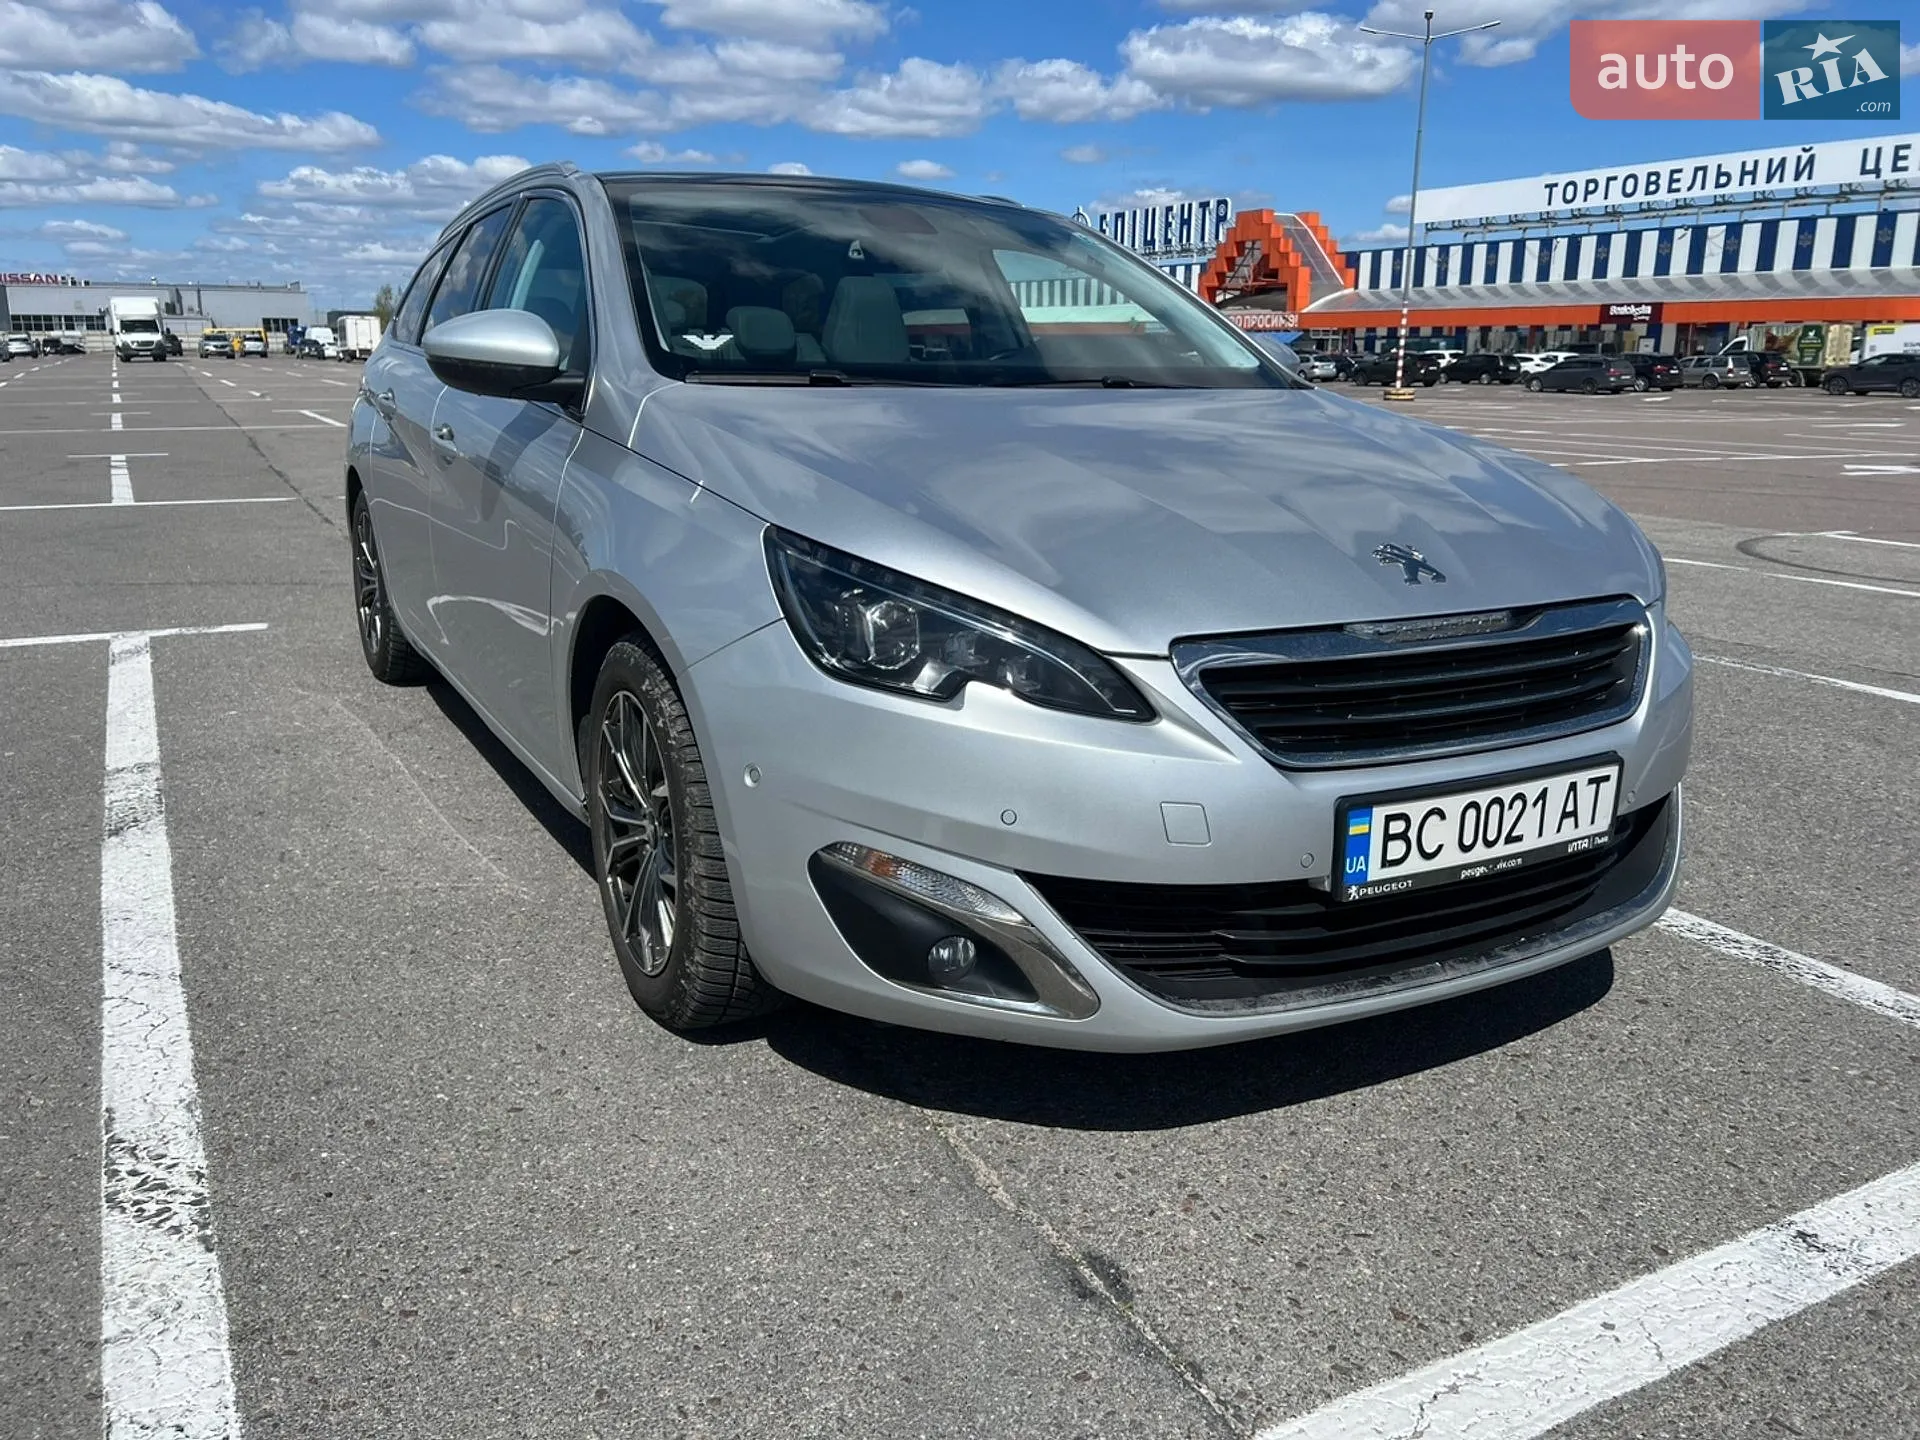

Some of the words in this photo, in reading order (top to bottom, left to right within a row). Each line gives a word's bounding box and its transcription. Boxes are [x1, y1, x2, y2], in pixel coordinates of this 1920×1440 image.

[1544, 147, 1816, 206] ТОРГОВЕЛЬНИЙ
[1860, 143, 1919, 179] ЦЕ
[1100, 198, 1231, 250] ЕПІЦЕНТР
[0, 273, 59, 285] ISSAN
[1380, 806, 1447, 869] BC
[1457, 786, 1549, 853] 0021
[1556, 774, 1611, 834] AT
[1346, 856, 1366, 874] UA
[1359, 880, 1413, 896] PEUGEOT
